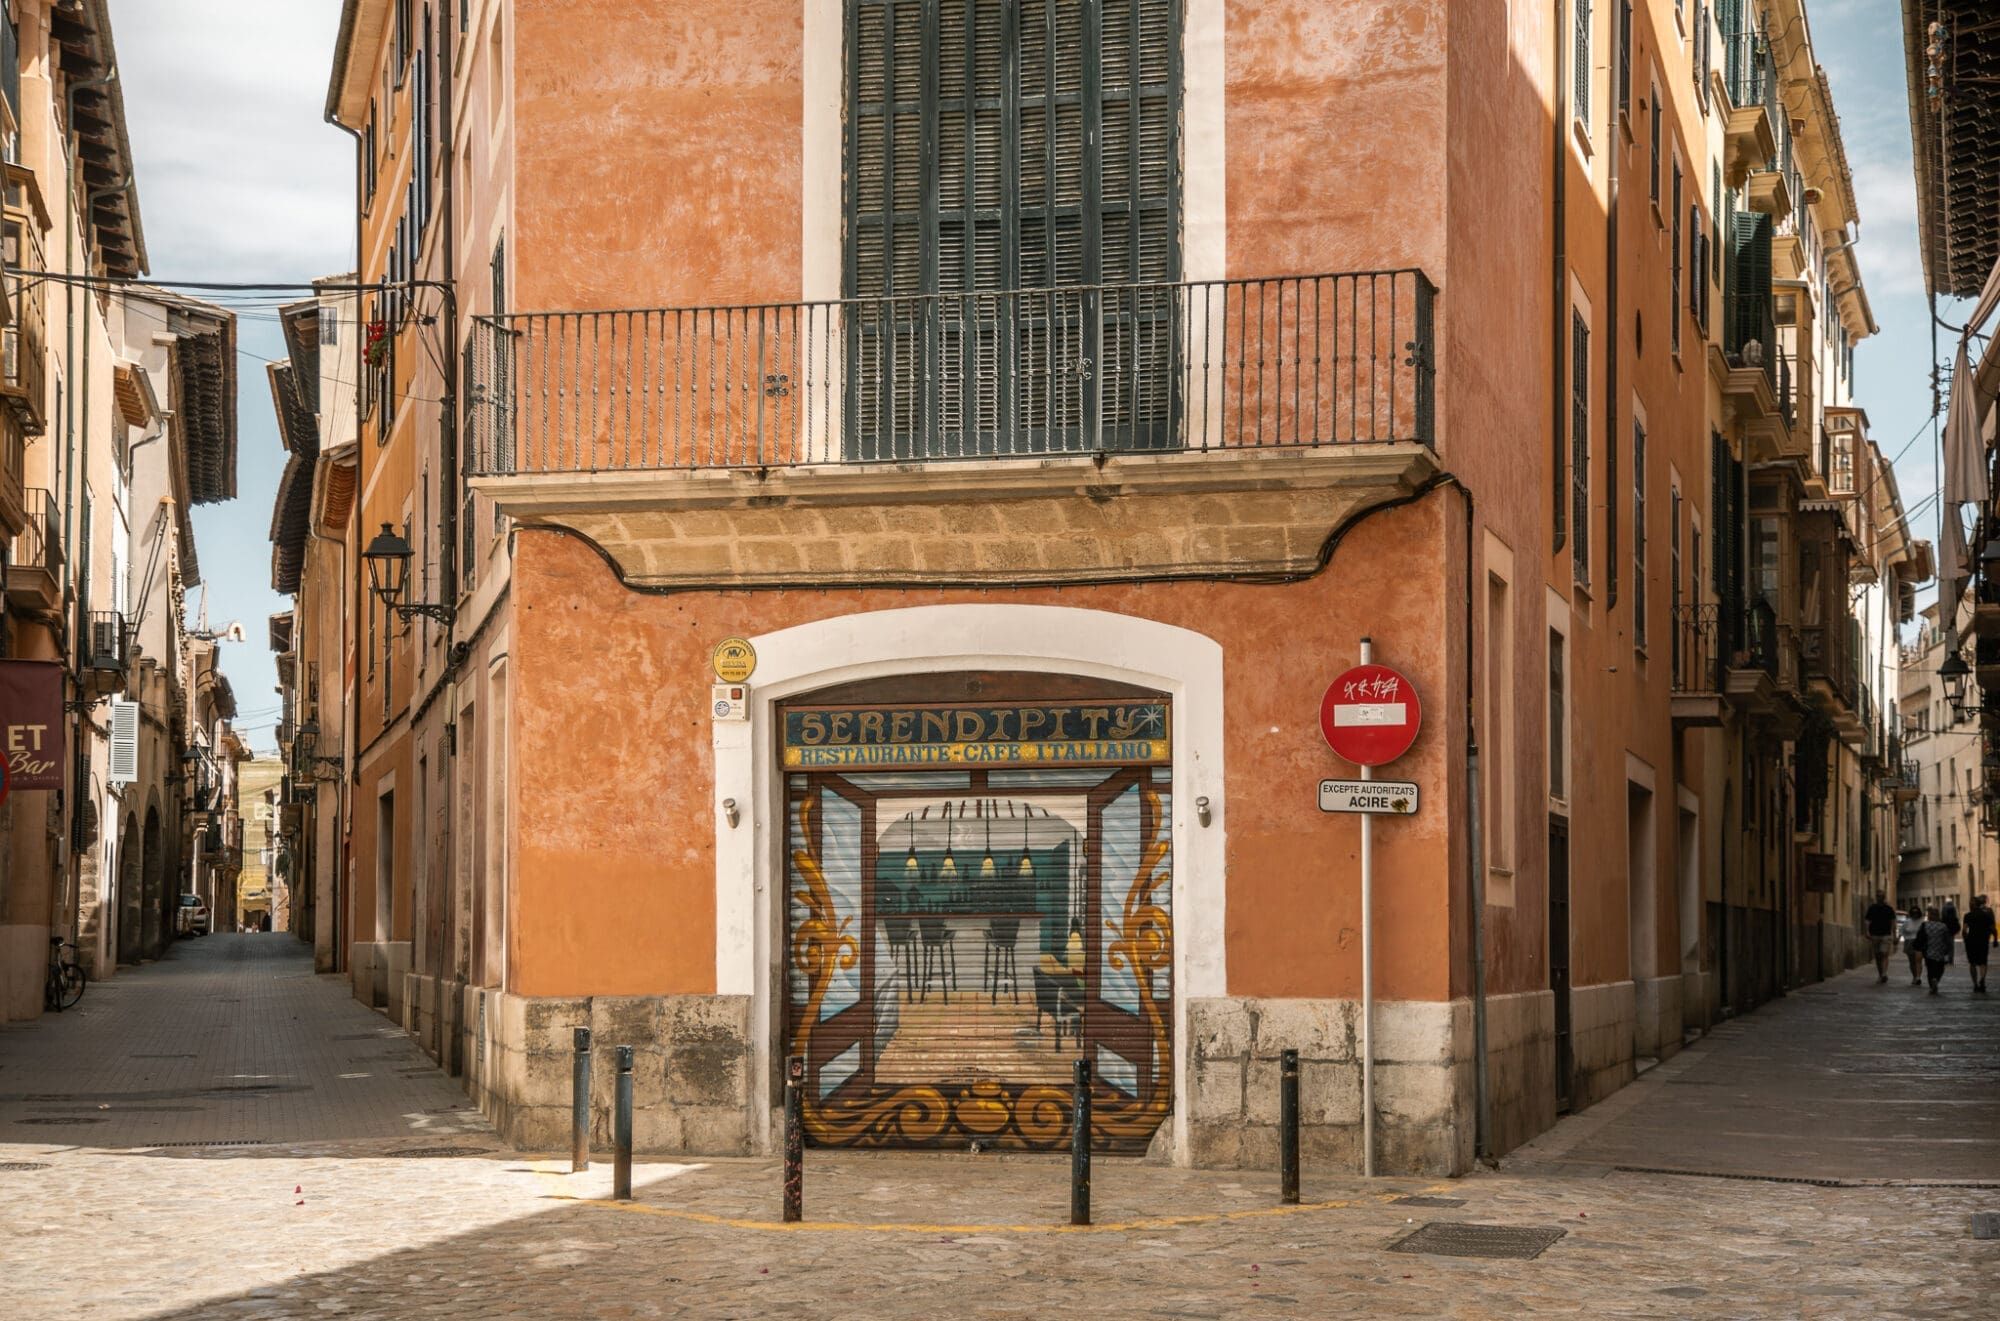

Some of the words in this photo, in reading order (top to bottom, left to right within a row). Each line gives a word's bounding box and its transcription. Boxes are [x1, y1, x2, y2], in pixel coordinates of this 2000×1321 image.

[8, 724, 47, 751] ET
[801, 707, 1149, 745] SERENDIPITY
[9, 751, 55, 775] Bar
[800, 743, 1022, 765] RESTAURANTE-CAFE
[1036, 741, 1153, 761] ITALIANO
[1323, 784, 1360, 794] EXCEPTE
[1361, 785, 1415, 796] AUTORITZATS
[1349, 796, 1389, 809] ACIRE
